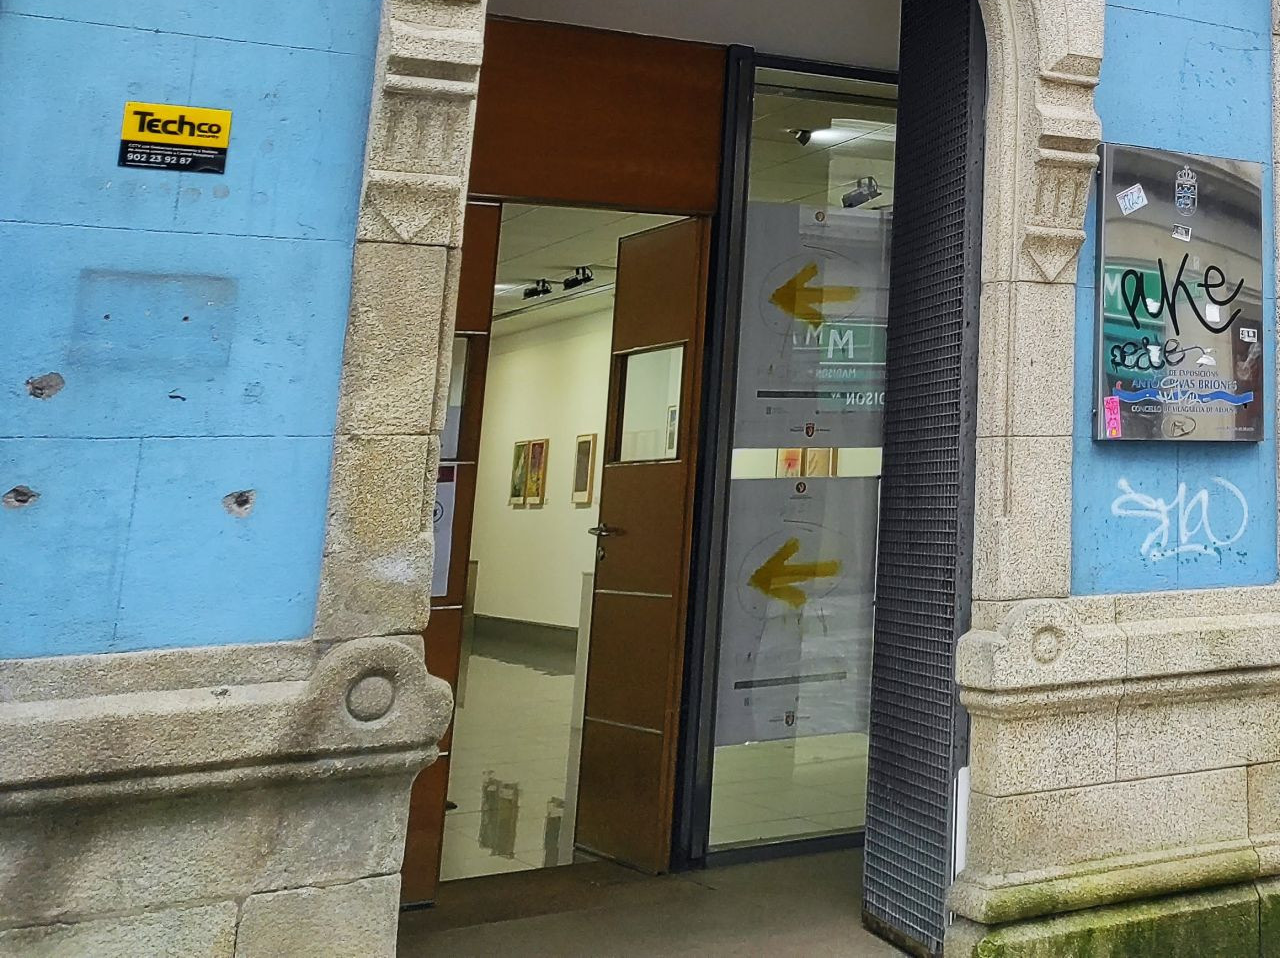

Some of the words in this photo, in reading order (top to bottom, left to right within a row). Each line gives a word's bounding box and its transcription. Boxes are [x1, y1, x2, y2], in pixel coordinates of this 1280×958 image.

[127, 152, 147, 162] 902
[149, 154, 161, 163] 23
[164, 156, 177, 164] 92
[179, 157, 192, 165] 87
[1198, 379, 1238, 391] BRIONES
[1132, 405, 1162, 413] CONCELLO
